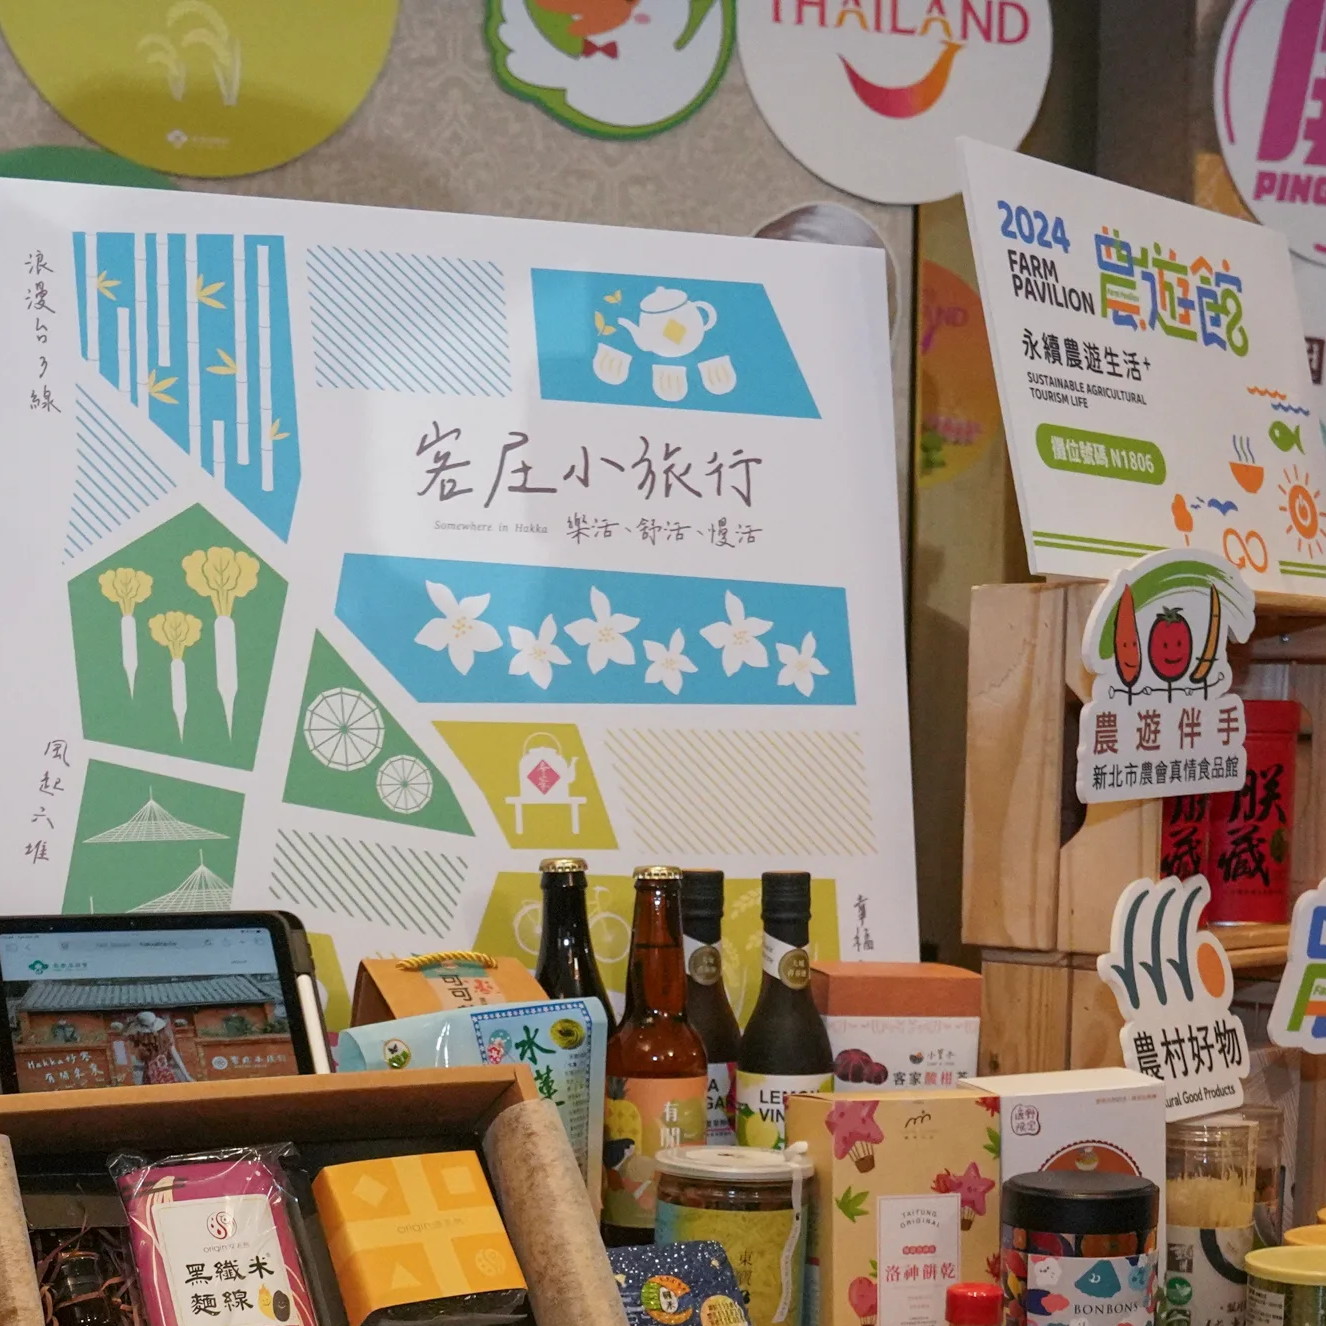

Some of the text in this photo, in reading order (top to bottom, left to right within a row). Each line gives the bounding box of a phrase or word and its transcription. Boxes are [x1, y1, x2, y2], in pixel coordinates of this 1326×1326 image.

[998, 200, 1071, 254] 2024
[1007, 249, 1060, 281] FARM
[1012, 276, 1095, 316] PAVILION
[1093, 225, 1249, 357] 農遊館
[1027, 372, 1147, 406] SUSTAINABLE AGRICULTURAL
[1029, 387, 1089, 410] TOURISM LIFE
[1110, 449, 1155, 473] N1806
[434, 519, 549, 535] Somewhere in Hakka
[1092, 705, 1241, 757] 農遊伴手
[1092, 755, 1240, 790] 新北市農會真情食品館
[1132, 1019, 1243, 1081] 農村好物
[184, 1255, 275, 1287] 黑纖米
[884, 1263, 957, 1282] 洛神餅乾
[190, 1289, 254, 1317] 麵線
[1074, 1301, 1139, 1316] BONBONS
